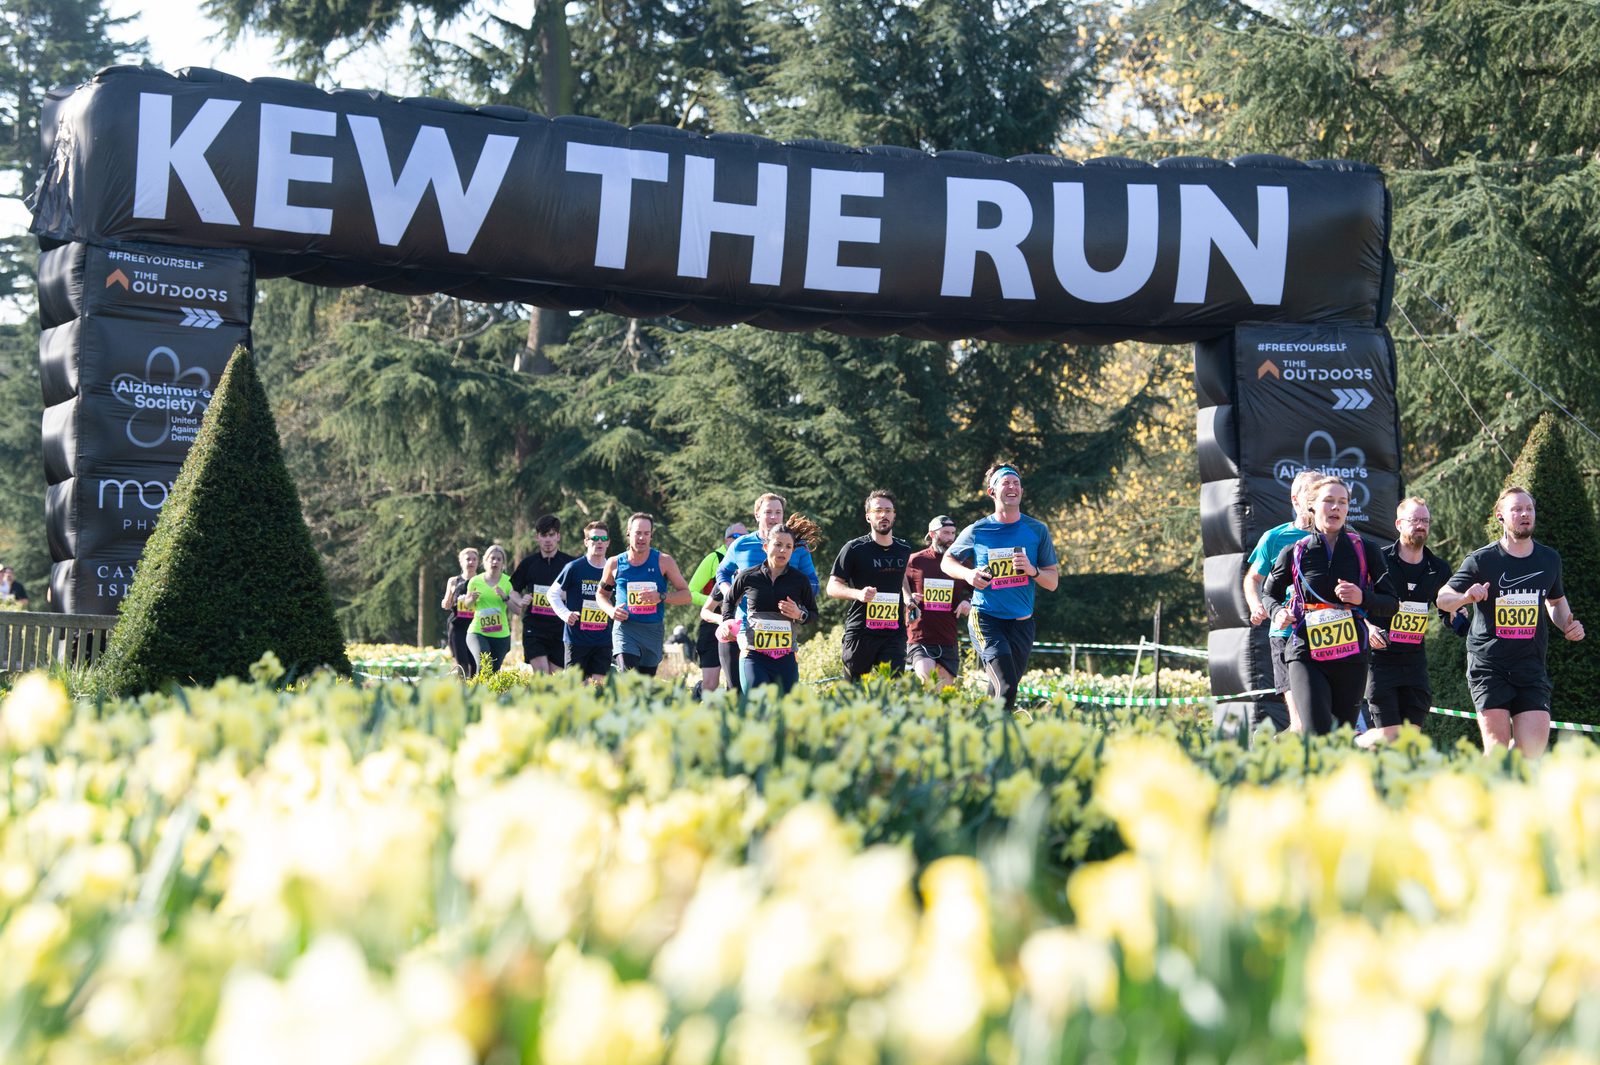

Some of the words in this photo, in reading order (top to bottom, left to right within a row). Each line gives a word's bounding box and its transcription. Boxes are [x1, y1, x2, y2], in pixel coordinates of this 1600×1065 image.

[133, 92, 519, 254] KEW
[565, 141, 885, 293] THE
[940, 177, 1290, 306] RUN
[108, 250, 204, 270] #FREEYOURSELF
[133, 271, 159, 281] TIME
[132, 280, 228, 302] OUTDOORS
[1257, 343, 1347, 352] #FREEYOURSELF
[1283, 359, 1306, 368] TIME
[1283, 368, 1373, 381] OUTDOORS
[116, 380, 212, 399] Alzheimer's
[134, 394, 196, 415] Society
[171, 416, 197, 425] United
[171, 433, 195, 442] Deme
[991, 560, 1013, 578] 027
[925, 588, 951, 602] 0205
[583, 609, 607, 623] 1762
[868, 604, 897, 620] 0224
[1497, 608, 1536, 626] 0302
[480, 615, 500, 627] 0361
[1393, 613, 1428, 632] 0357
[756, 632, 790, 648] 0715
[1310, 620, 1355, 648] 0370
[1315, 649, 1335, 659] KEW
[1336, 644, 1356, 656] HALF
